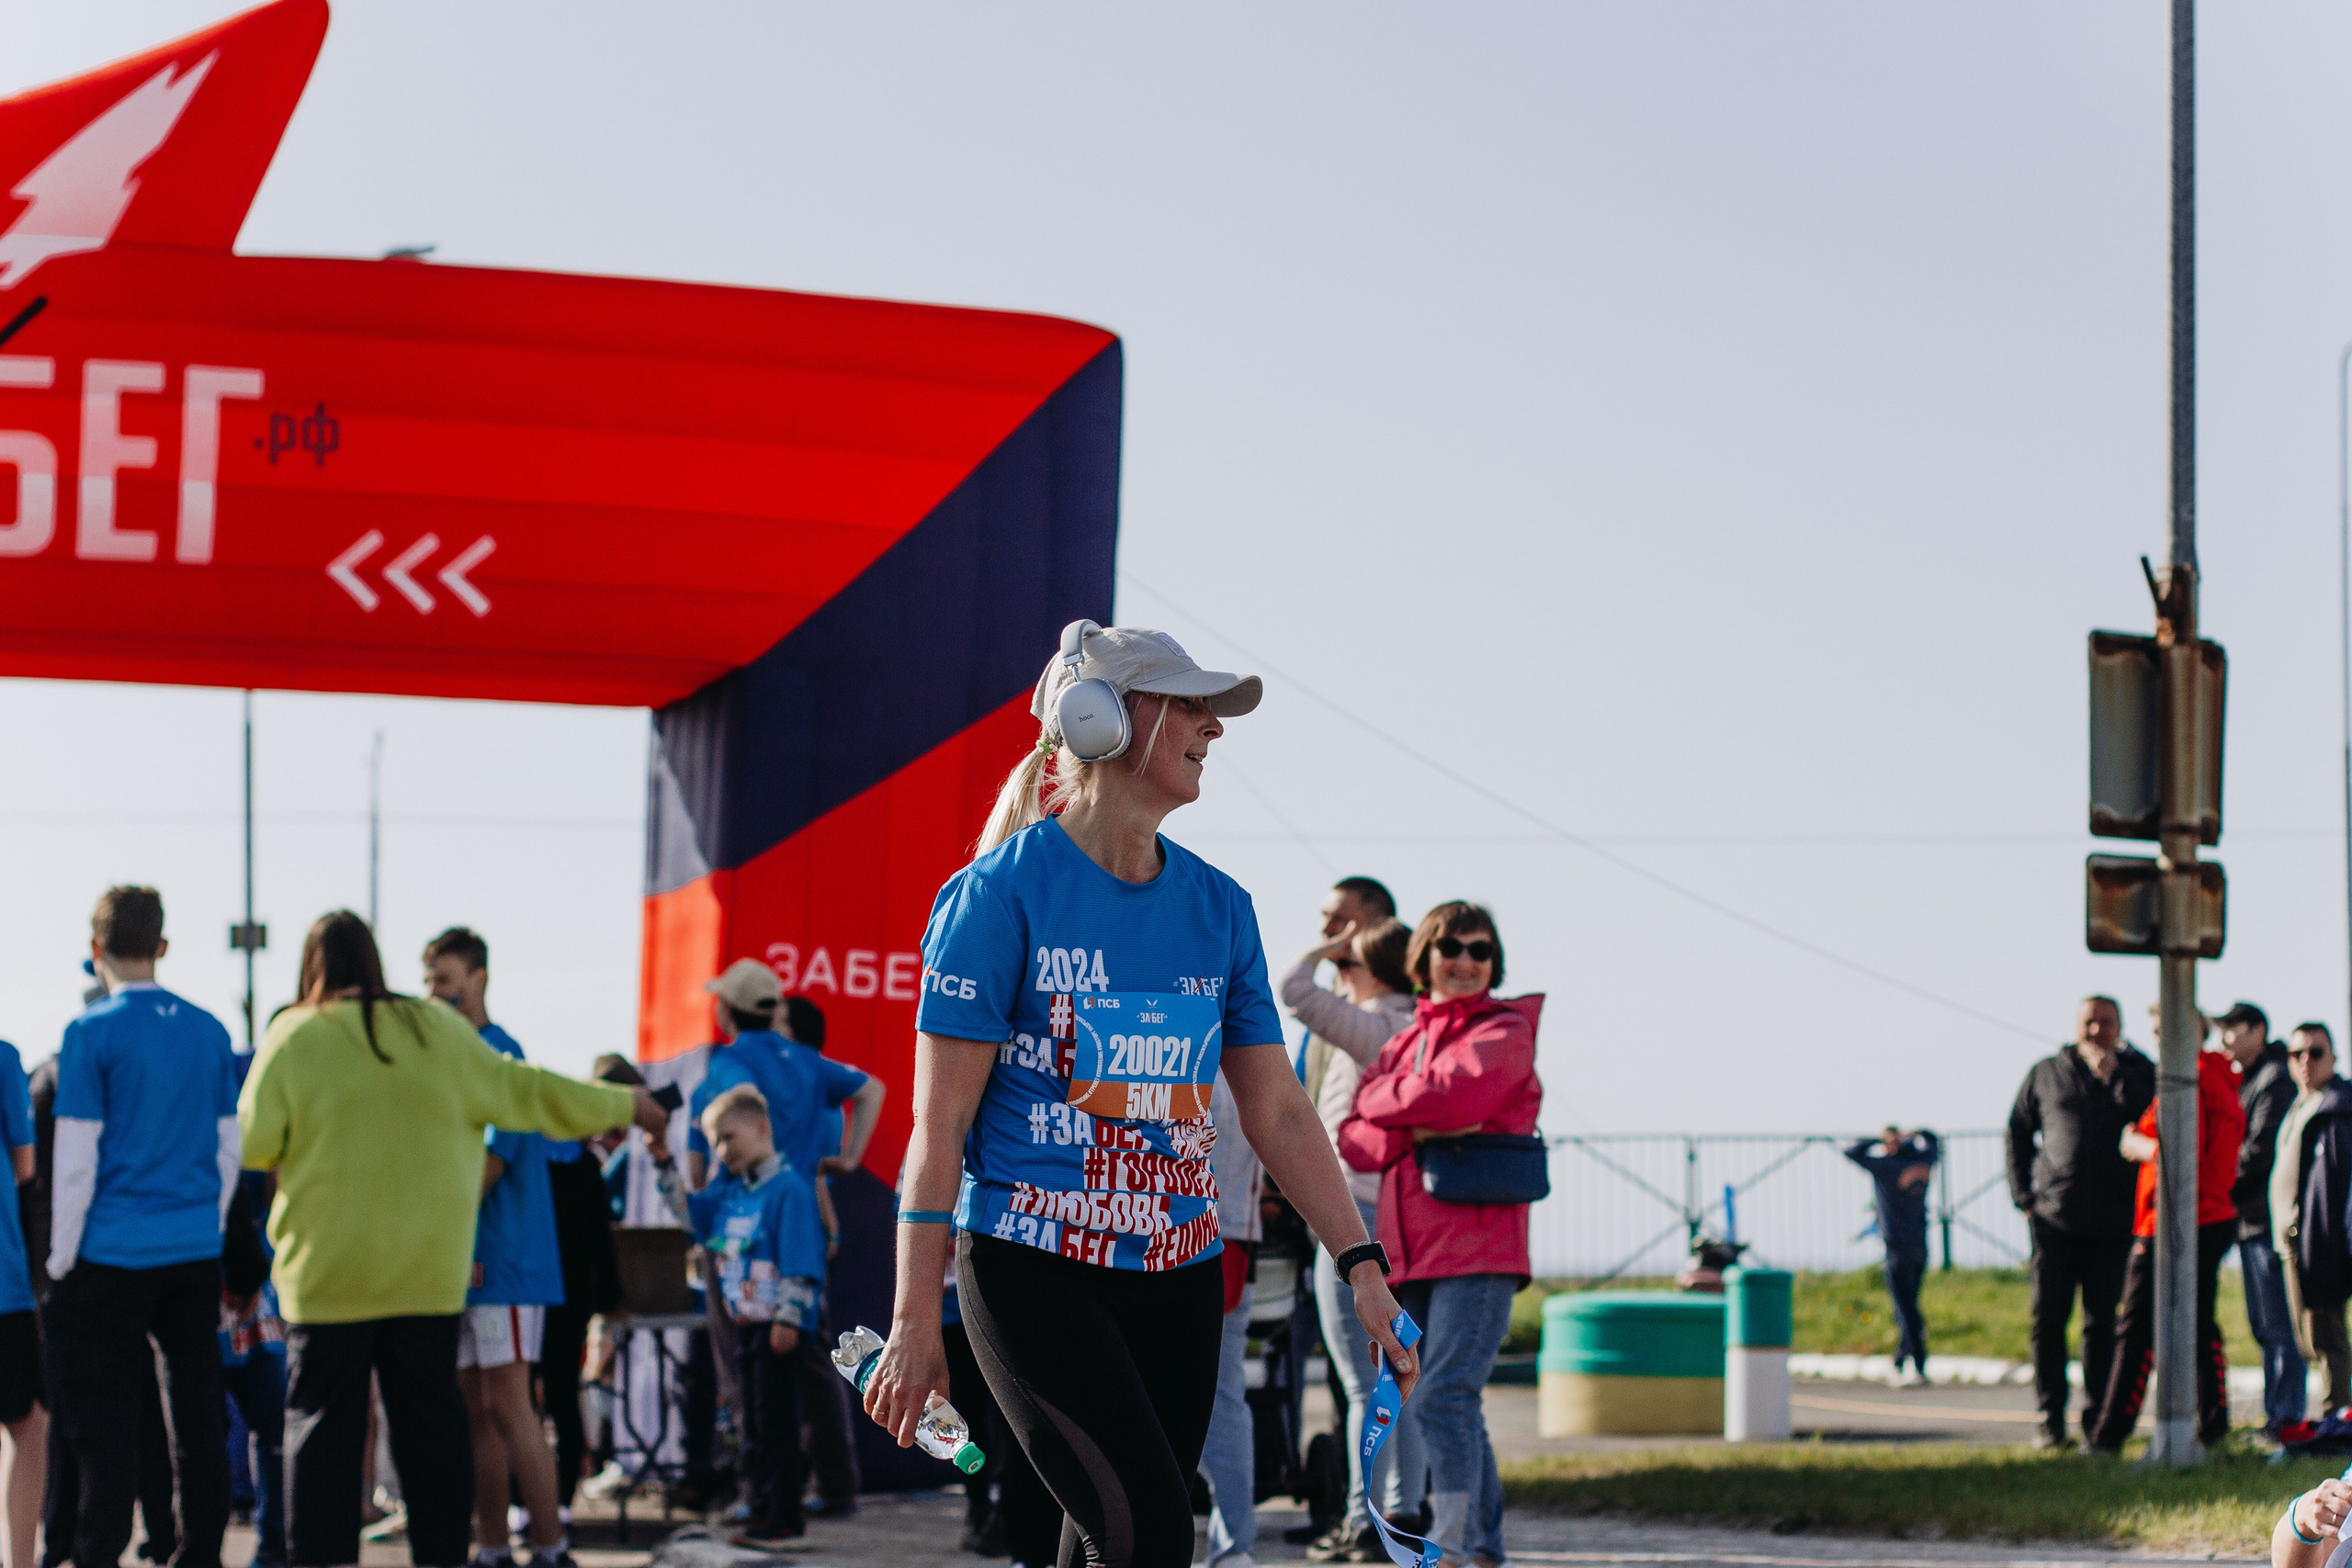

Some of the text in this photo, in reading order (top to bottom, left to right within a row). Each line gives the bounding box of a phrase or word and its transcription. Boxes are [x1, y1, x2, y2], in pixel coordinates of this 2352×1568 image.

[766, 942, 920, 1001] ЗАБЕ
[929, 969, 978, 1000] ПСБ
[1035, 946, 1110, 992] 2024
[1097, 998, 1121, 1009] ПСБ
[999, 1030, 1077, 1077] #ЗАБ
[1108, 1033, 1192, 1077] 20021
[1363, 1425, 1383, 1457] ПСБ
